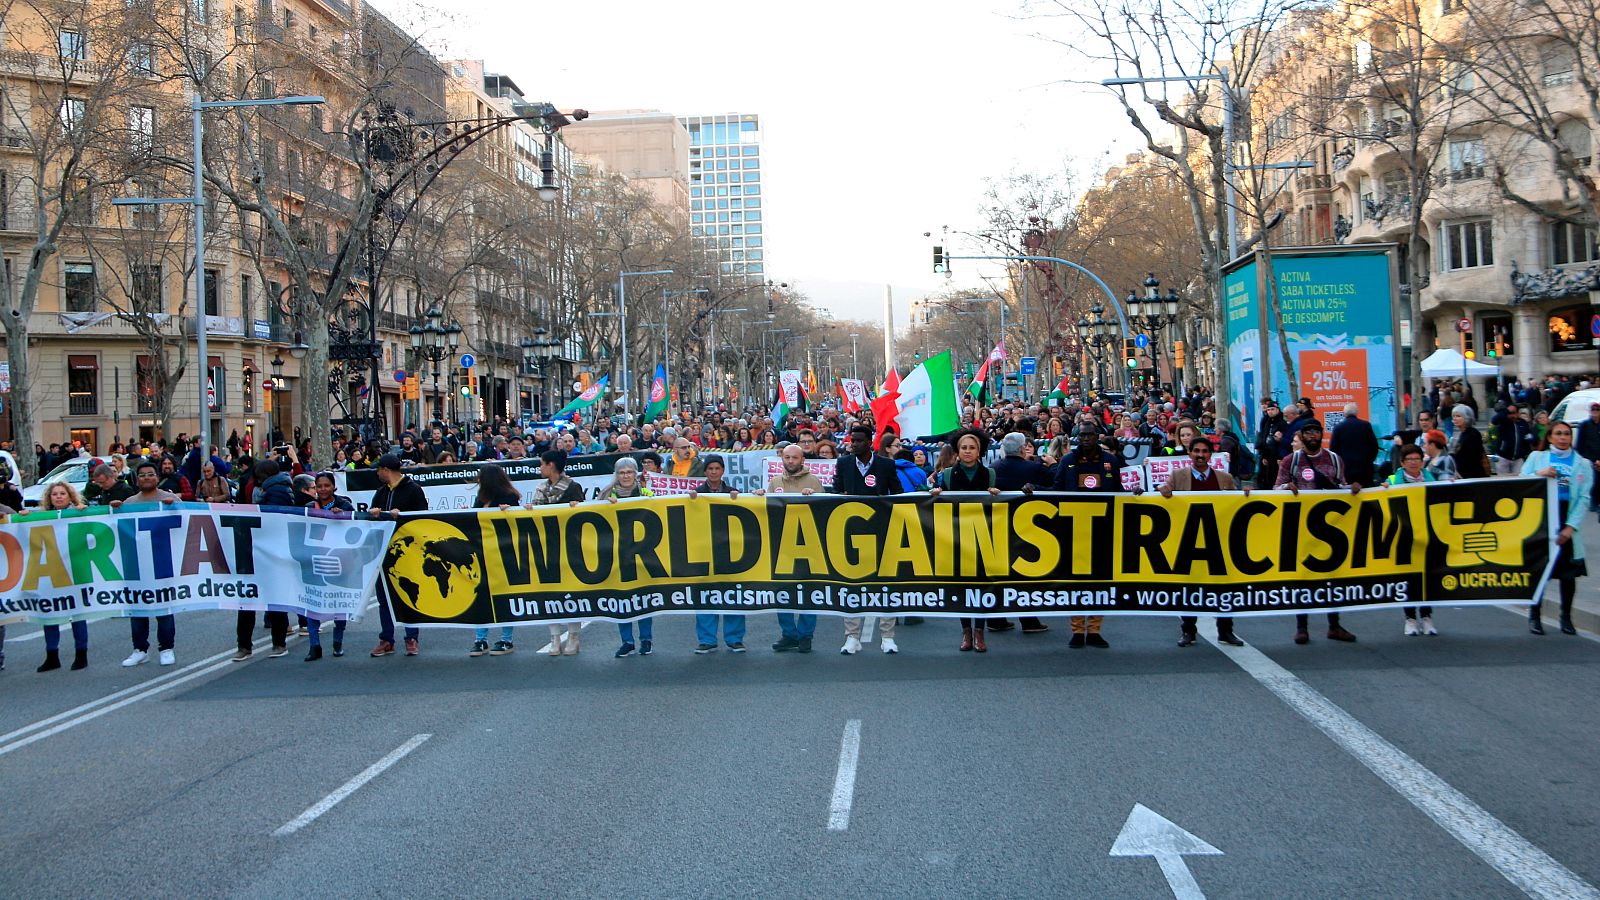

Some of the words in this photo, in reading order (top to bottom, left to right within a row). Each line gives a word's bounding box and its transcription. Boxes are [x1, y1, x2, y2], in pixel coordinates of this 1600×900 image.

[1281, 272, 1310, 283] ACTIVA
[1281, 285, 1304, 296] SABA
[1282, 298, 1312, 310] ACTIVA
[1314, 298, 1325, 309] UN
[1327, 297, 1347, 308] 25%
[1283, 313, 1293, 323] DE
[728, 454, 750, 475] EL
[1151, 461, 1168, 473] ES
[651, 477, 668, 489] ES
[490, 503, 762, 586] WORLD
[774, 500, 1107, 580] AGAINST
[1121, 496, 1415, 576] RACISM
[1459, 571, 1532, 588] UCFR.CAT
[198, 578, 259, 599] dreta
[323, 590, 352, 599] contra
[328, 599, 337, 608] el
[509, 597, 539, 617] Un
[545, 593, 592, 615] món
[597, 590, 664, 614] contra
[671, 586, 694, 605] el
[700, 583, 790, 605] racisme
[797, 584, 804, 604] i
[811, 585, 833, 605] el
[838, 586, 945, 608] feixisme!
[965, 588, 997, 608] No
[1003, 586, 1116, 607] Passaran!
[1136, 581, 1409, 612] worldagainstracism.org
